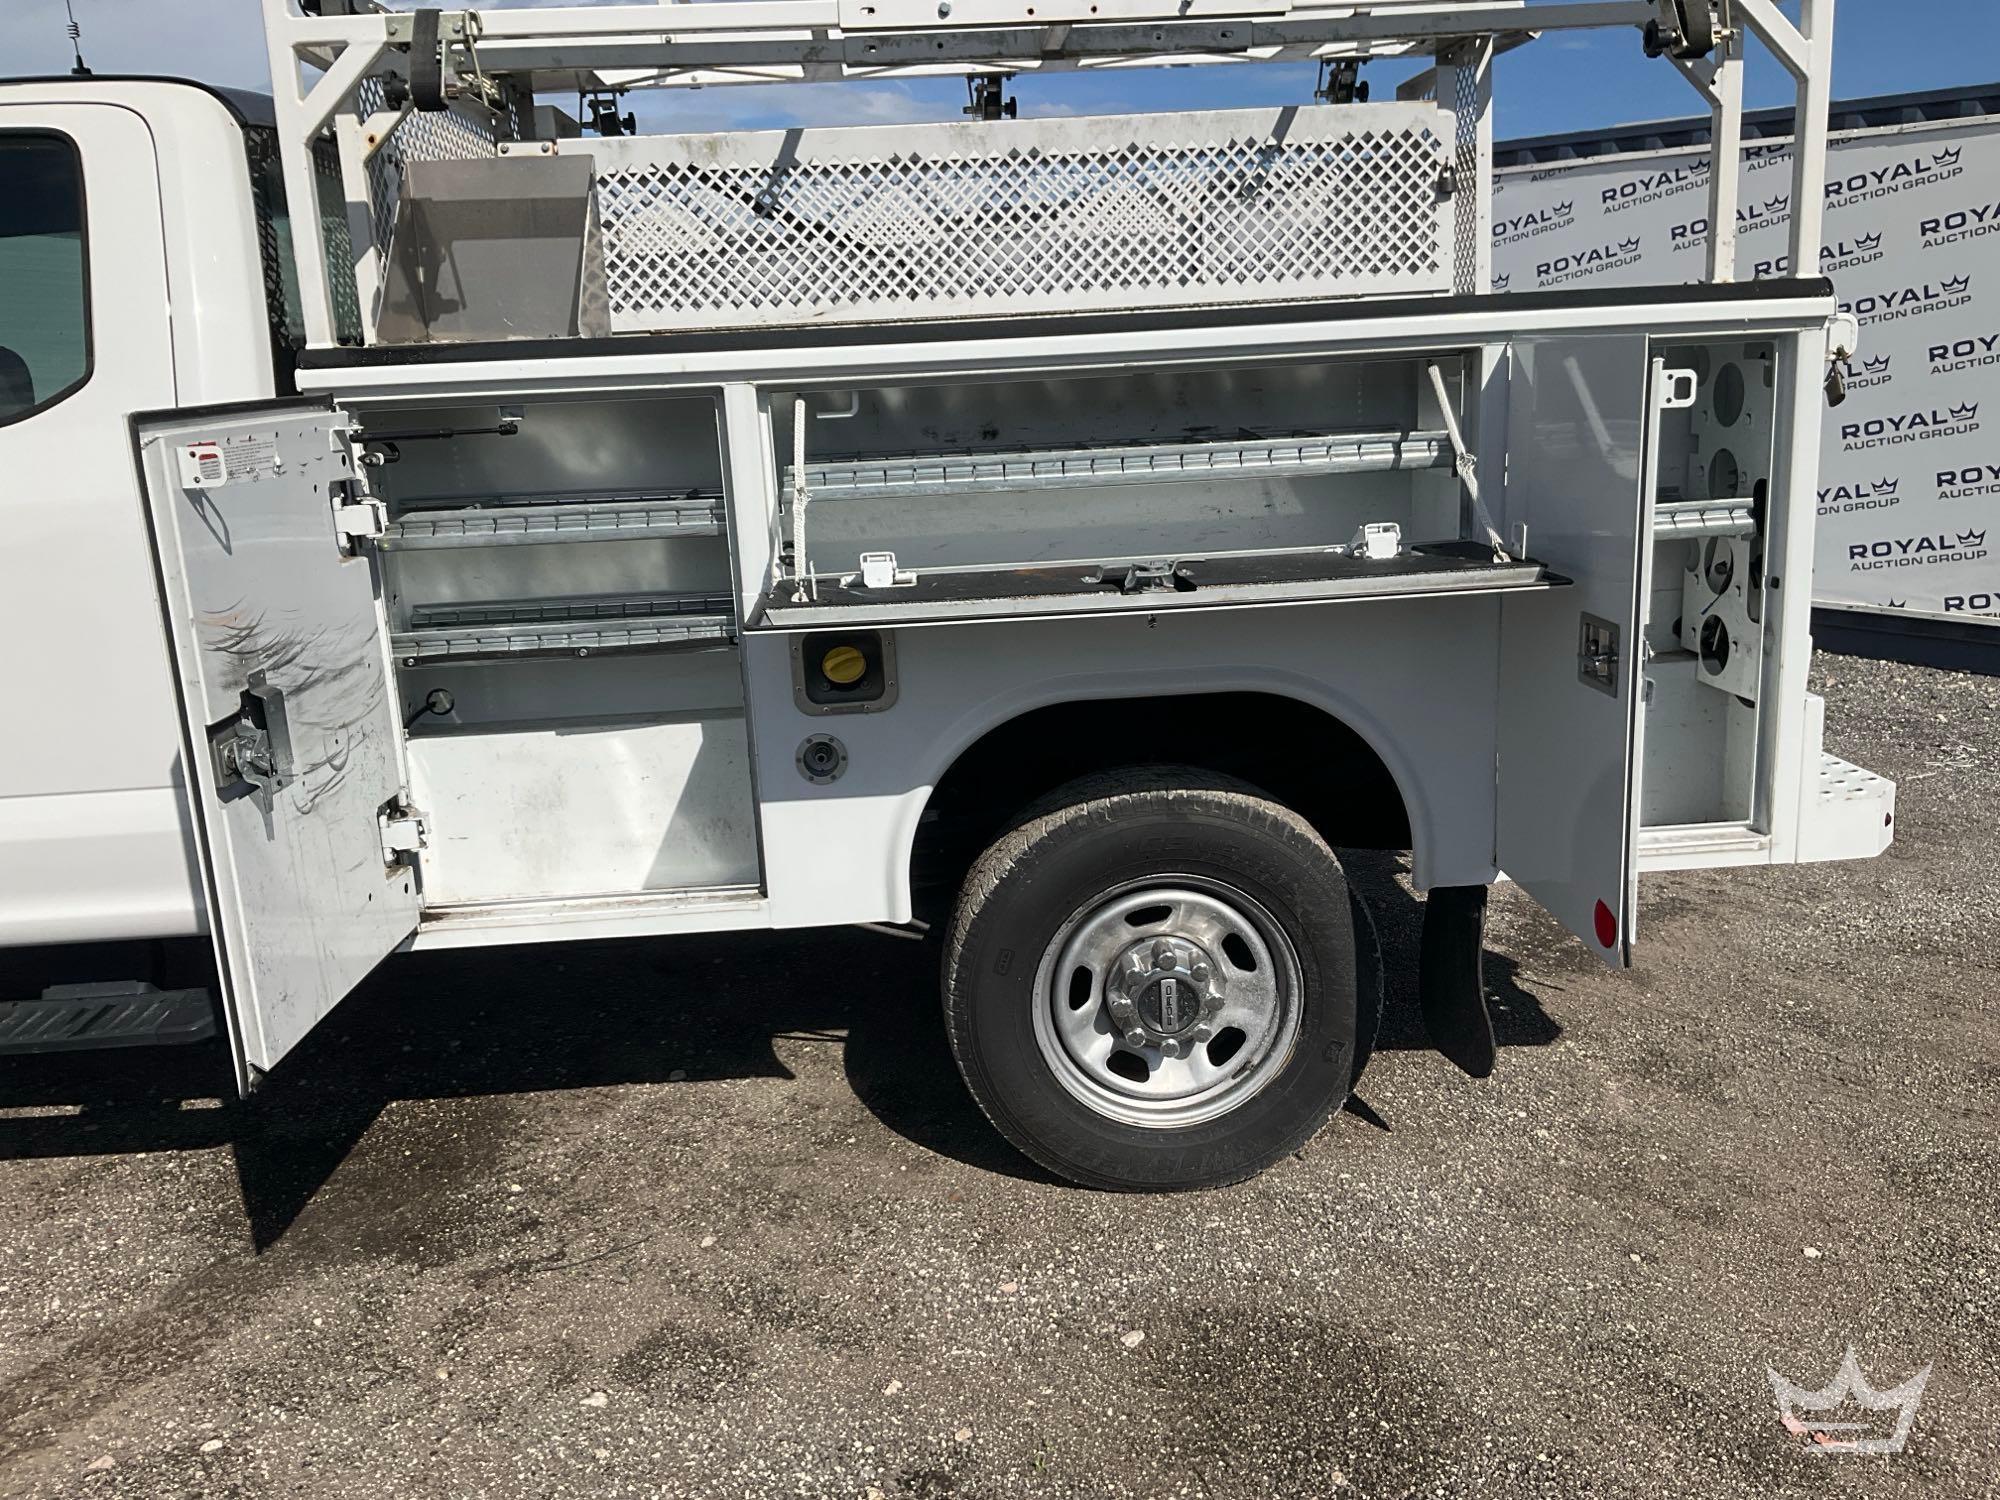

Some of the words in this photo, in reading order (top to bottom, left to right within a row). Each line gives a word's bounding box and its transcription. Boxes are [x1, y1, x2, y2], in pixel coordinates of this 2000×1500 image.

[1747, 153, 1793, 174] AUCTI
[1824, 157, 1931, 199] ROYAL
[1601, 167, 1688, 204] ROYAL
[1826, 184, 1899, 211] AUCTION
[1902, 166, 1963, 190] GROUP
[1603, 190, 1662, 216] AUCTION
[1491, 230, 1529, 248] CTION
[1531, 217, 1575, 237] GROUP
[1492, 209, 1552, 238] OYAL
[1672, 236, 1708, 253] AUCT
[1738, 213, 1791, 235] GROUP
[1921, 201, 2000, 236] ROY
[1922, 222, 2000, 249] AUCTION
[1536, 245, 1618, 278] ROYAL
[1537, 265, 1593, 289] AUCTION
[1595, 253, 1642, 273] GROUP
[1827, 252, 1884, 272] GROUP
[1857, 308, 1907, 327] CTION
[1911, 295, 1972, 315] GROUP
[1928, 333, 2000, 363] ROY
[1843, 374, 1892, 392] ROUP
[1841, 410, 1948, 440] ROYAL
[1843, 435, 1916, 452] AUCTION
[1919, 422, 1980, 441] GROUP
[1936, 464, 2000, 488] ROY
[1817, 484, 1871, 503] YAL
[1843, 497, 1900, 513] GROUP
[1938, 484, 2000, 500] AUCTIO
[1848, 534, 1956, 560] ROYAL
[1850, 555, 1923, 572] AUCTION
[1926, 549, 1987, 565] GROUP
